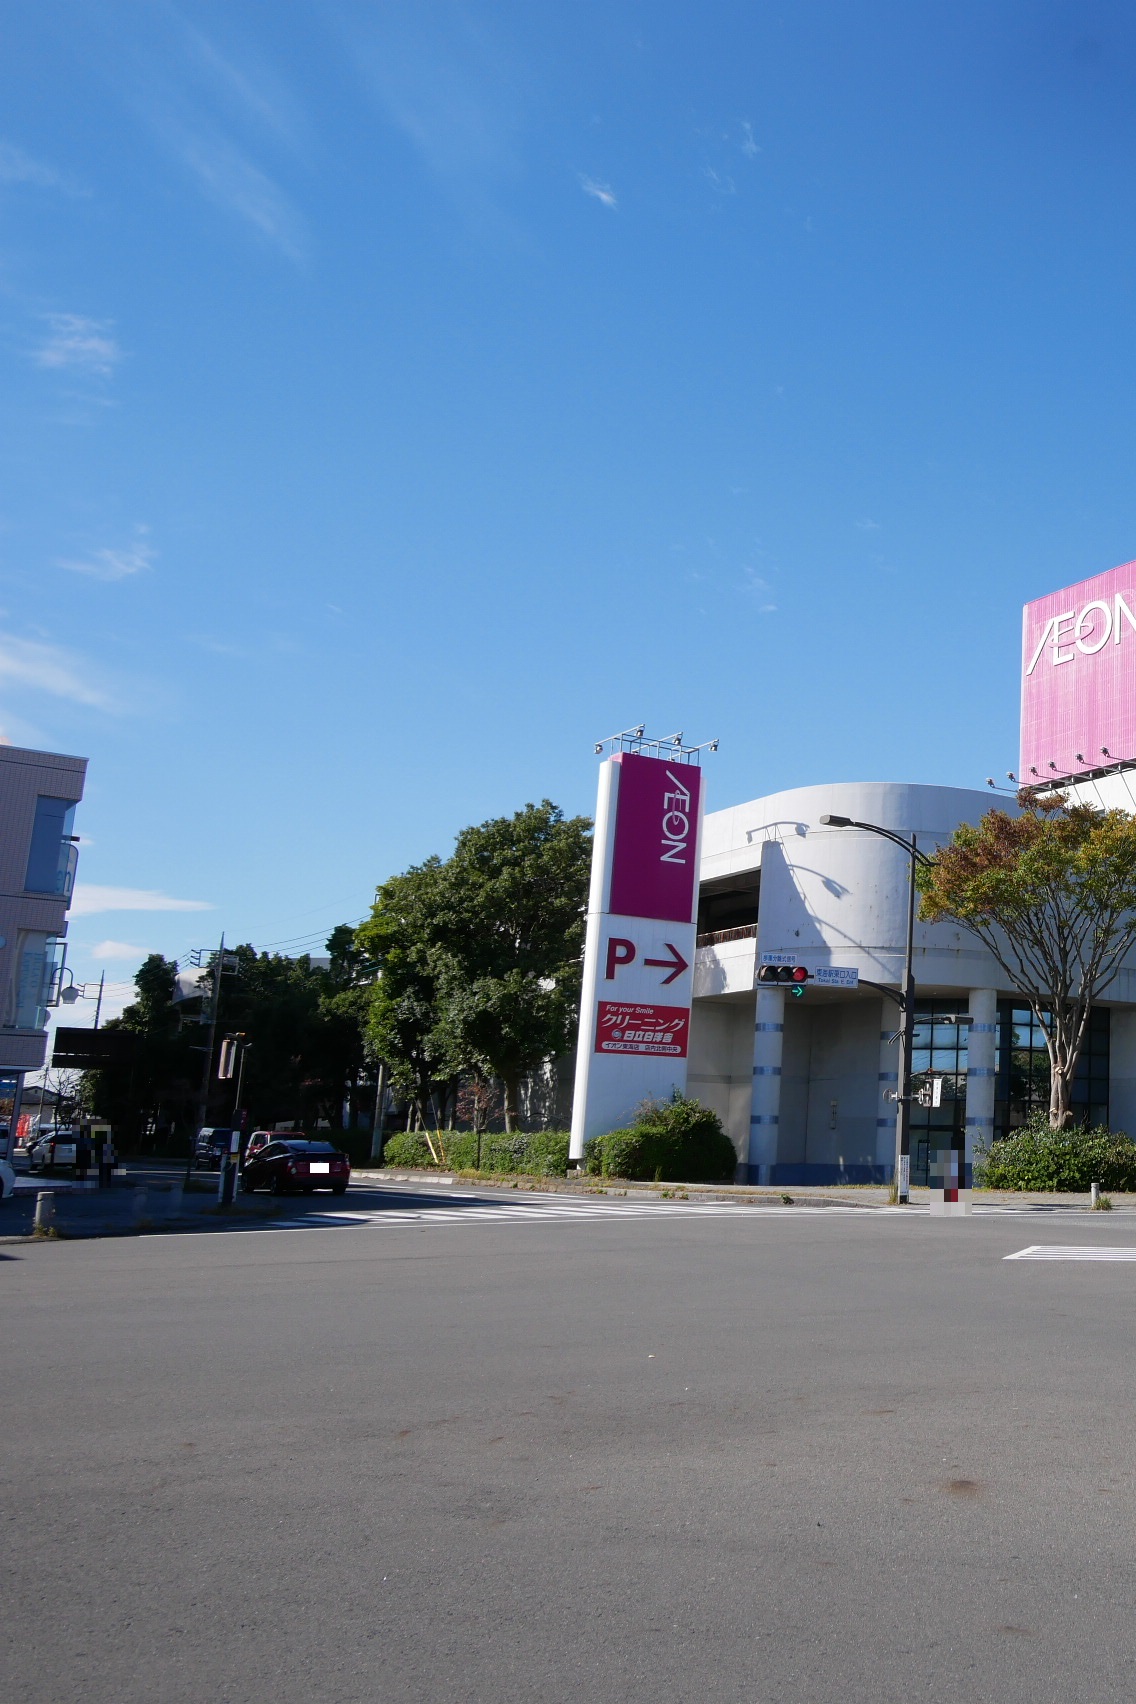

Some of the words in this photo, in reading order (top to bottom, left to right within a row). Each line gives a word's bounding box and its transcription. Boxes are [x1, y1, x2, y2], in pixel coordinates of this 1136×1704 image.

[605, 937, 636, 979] P
[606, 1004, 618, 1012] For
[635, 1007, 654, 1015] Smile
[601, 1013, 686, 1031] クリーニング
